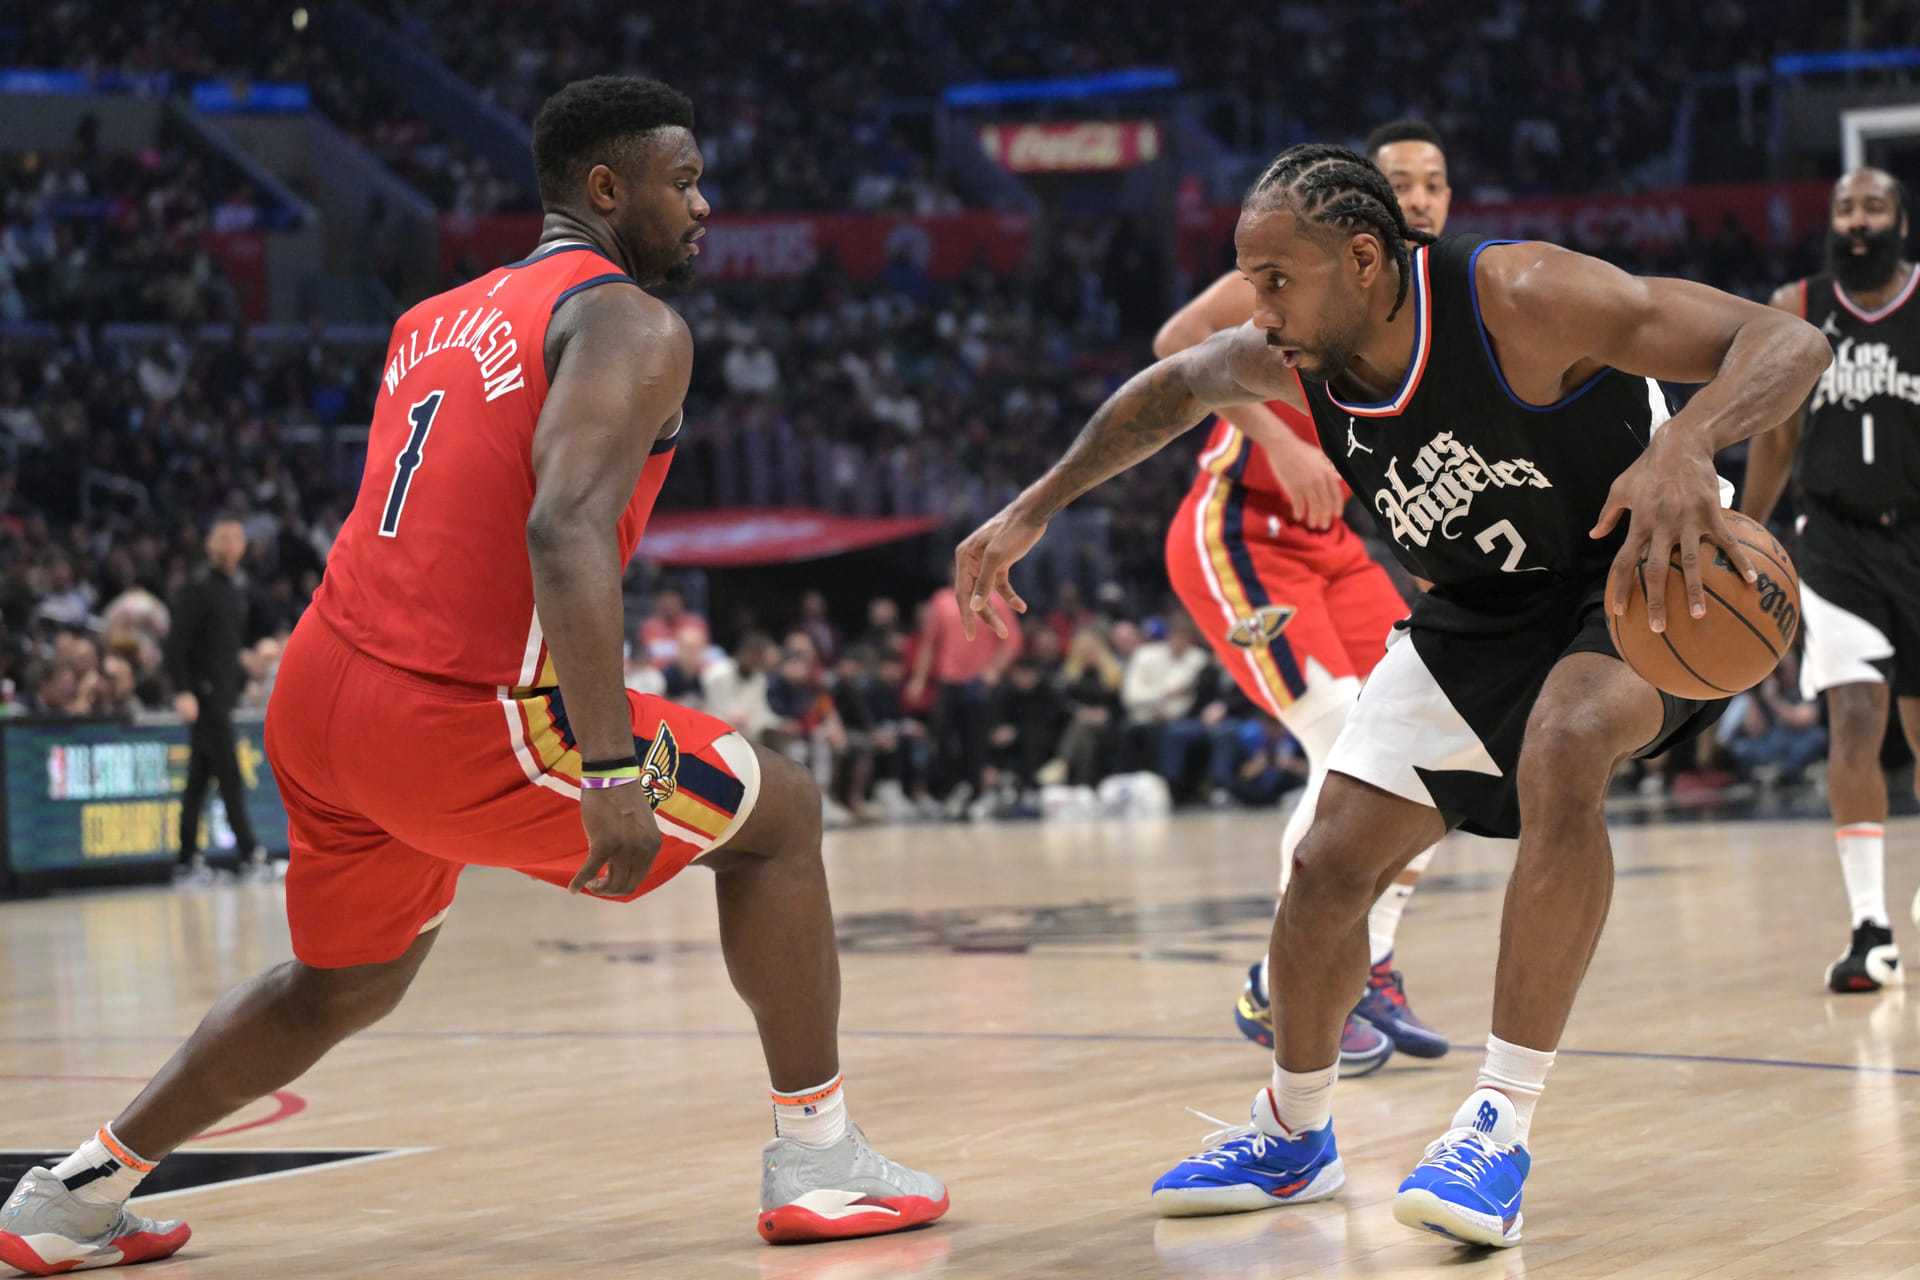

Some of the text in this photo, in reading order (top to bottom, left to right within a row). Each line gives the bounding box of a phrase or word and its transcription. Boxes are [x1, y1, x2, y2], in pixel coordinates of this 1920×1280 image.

[384, 307, 525, 403] WILLIAMSON
[378, 390, 446, 538] 1
[1384, 430, 1471, 509] Los
[1861, 413, 1875, 465] 1
[1374, 445, 1554, 551] Angeles
[1473, 518, 1549, 573] 2
